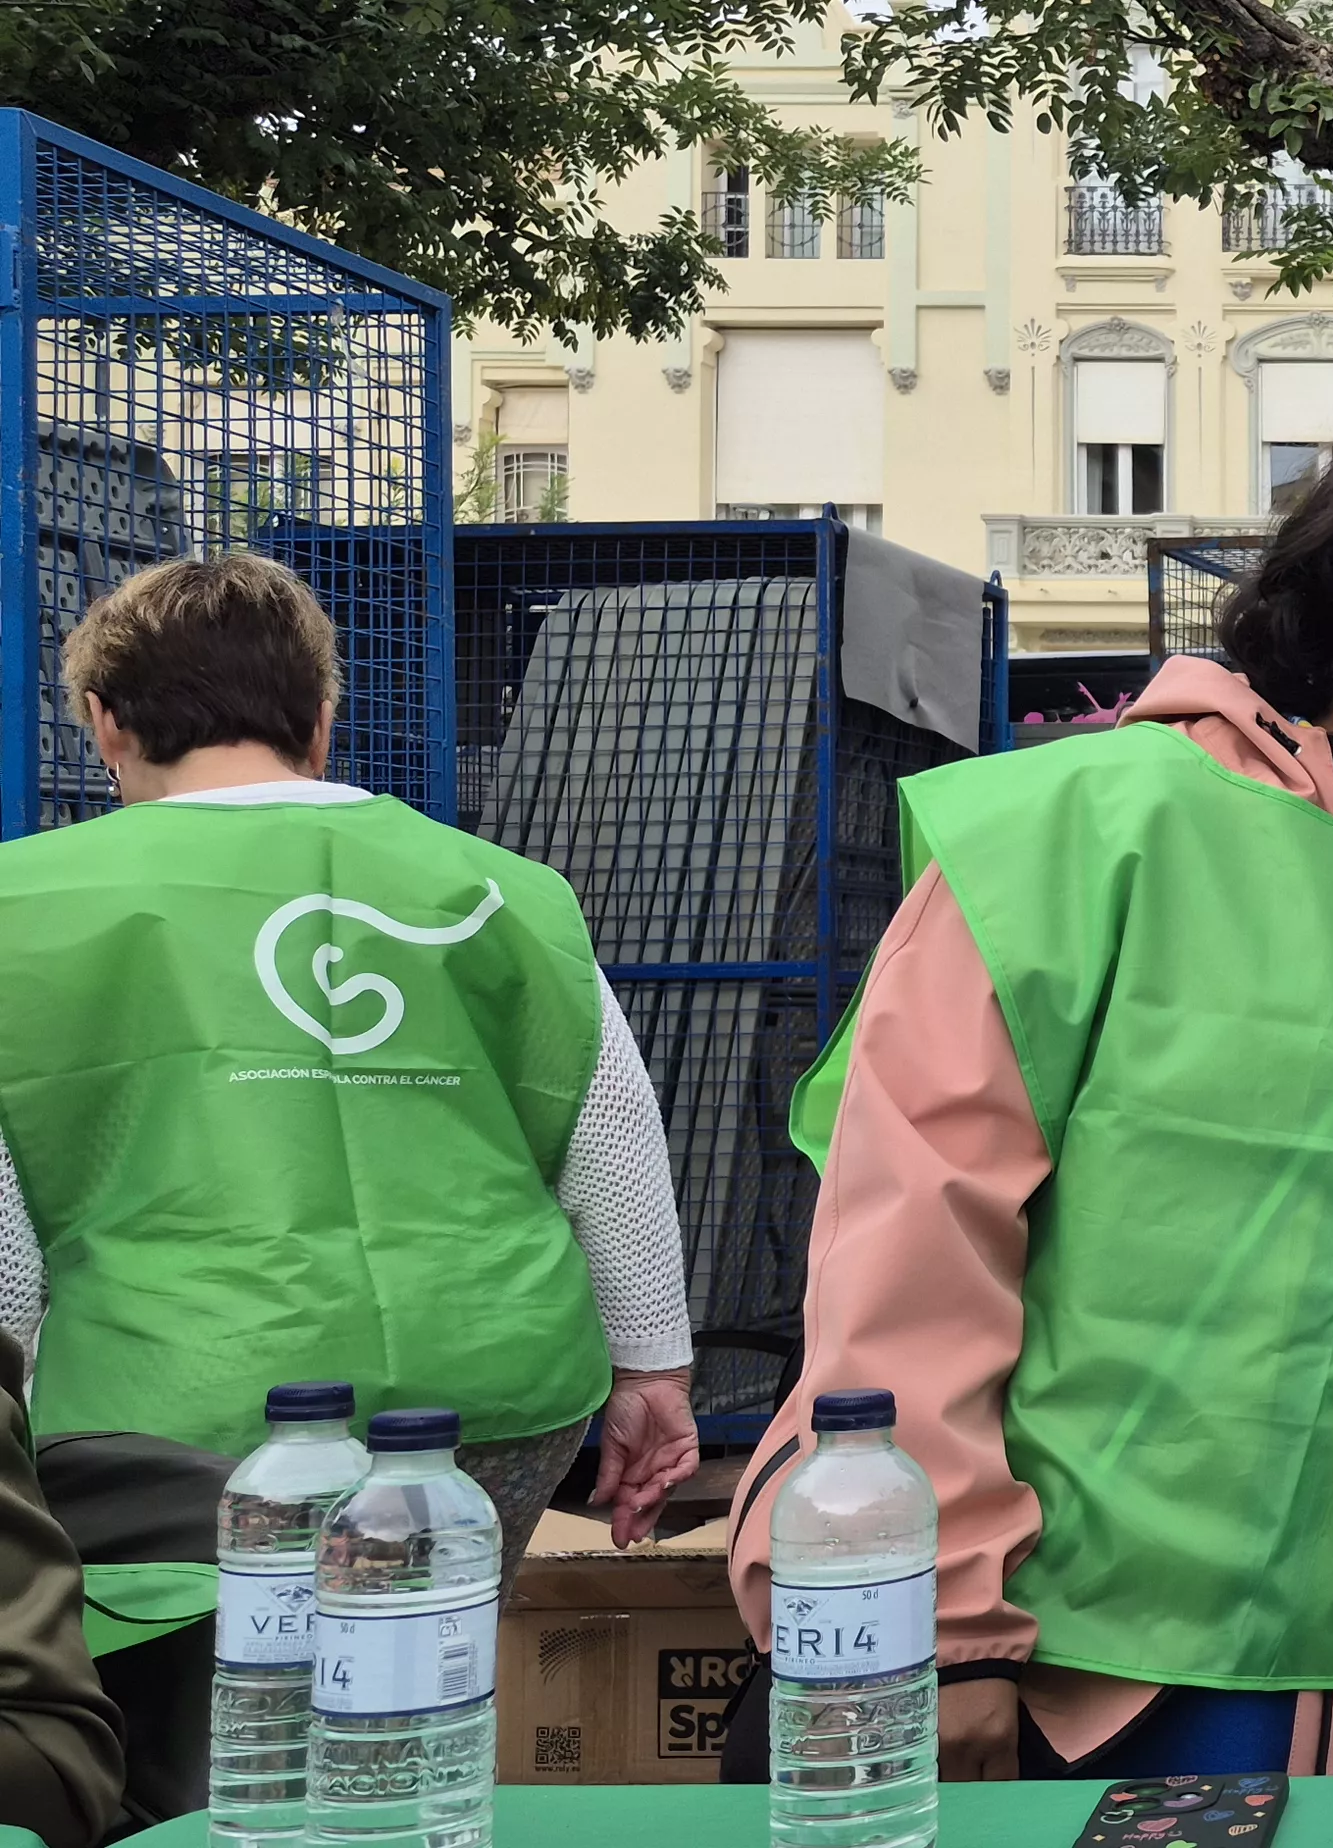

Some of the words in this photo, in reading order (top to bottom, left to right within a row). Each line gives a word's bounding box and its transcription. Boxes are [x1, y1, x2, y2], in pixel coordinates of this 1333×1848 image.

[229, 1067, 310, 1083] ASOCIACIÓN
[352, 1074, 398, 1086] CONTRA
[400, 1075, 413, 1085] EL
[415, 1073, 461, 1086] CÁNCER
[861, 1590, 872, 1600] 50
[1122, 1831, 1166, 1841] Happy
